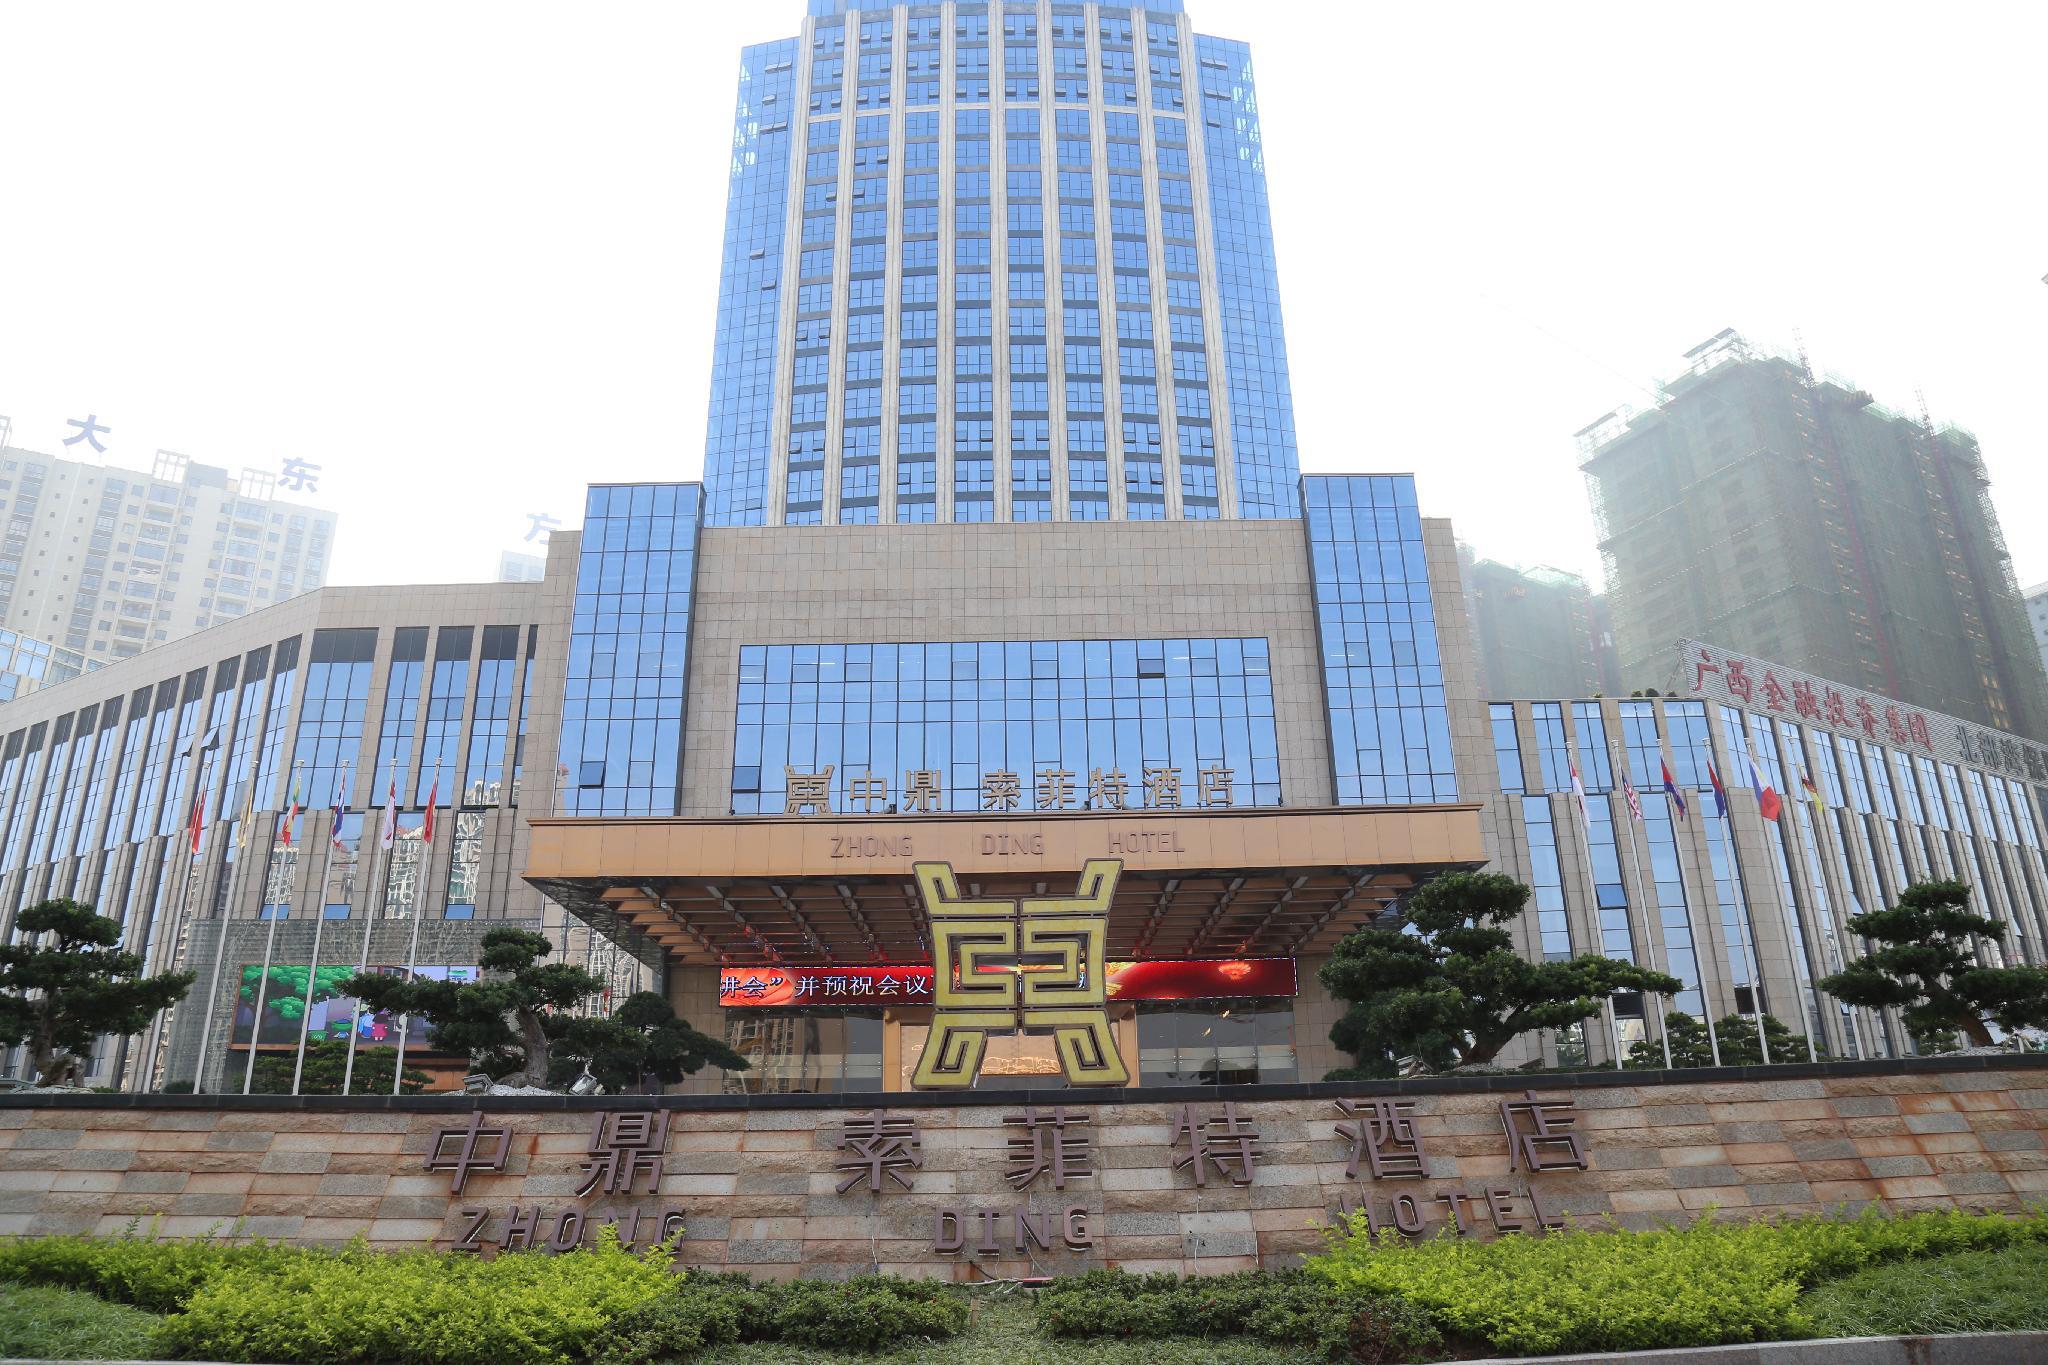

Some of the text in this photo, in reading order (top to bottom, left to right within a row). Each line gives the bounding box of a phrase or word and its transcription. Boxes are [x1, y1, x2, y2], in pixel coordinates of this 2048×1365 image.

[1692, 649, 1934, 752] 广西金融投资集团
[830, 831, 1185, 858] ZHONG DING HOTEL
[450, 1205, 687, 1256] ZHONG
[935, 1203, 1093, 1255] DING
